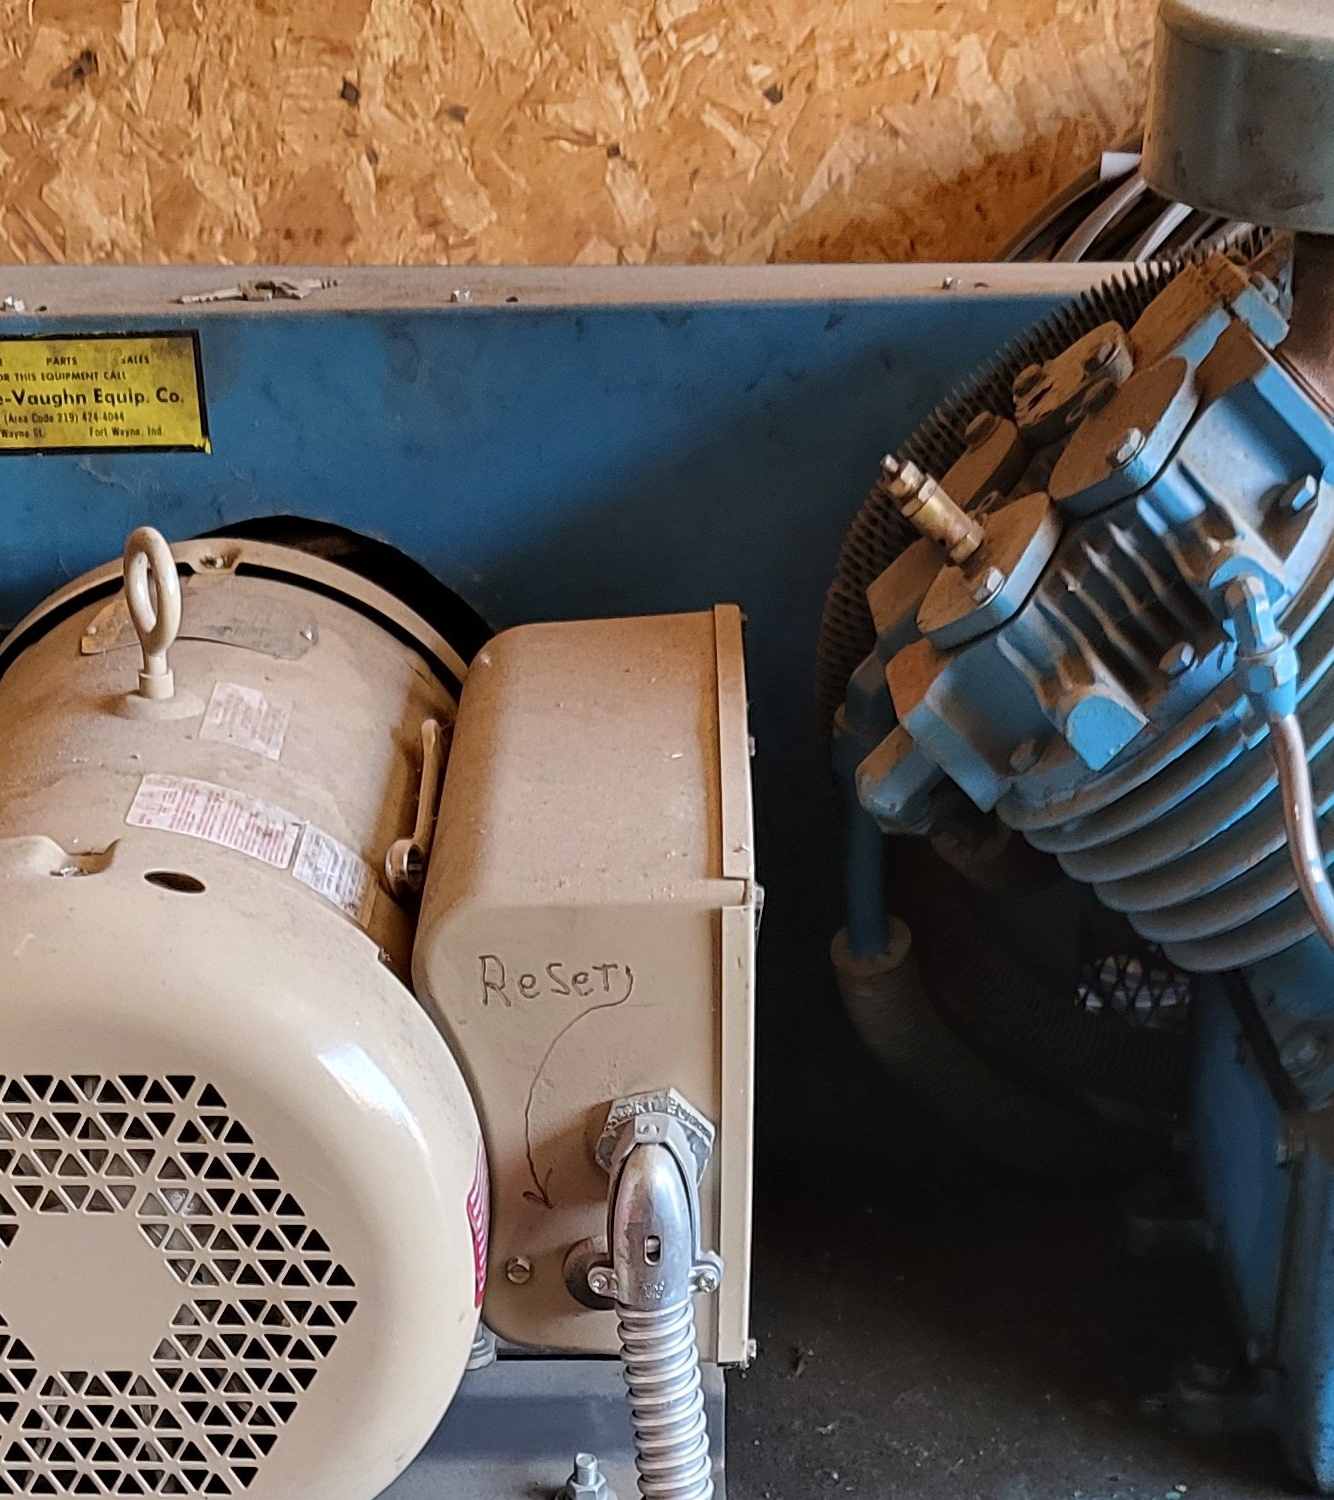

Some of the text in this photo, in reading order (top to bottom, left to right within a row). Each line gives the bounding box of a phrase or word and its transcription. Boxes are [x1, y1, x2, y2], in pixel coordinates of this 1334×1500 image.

[46, 357, 78, 366] PARTS
[121, 355, 150, 365] SALES
[15, 372, 37, 381] THIS
[41, 371, 99, 381] EQUIPMENT
[104, 370, 126, 380] CALL
[93, 387, 150, 407] Equip.
[156, 387, 184, 403] Co.
[4, 413, 29, 425] (Area
[31, 413, 54, 423] Code
[57, 412, 79, 424] 219)
[0, 428, 29, 440] Wayne
[89, 426, 108, 437] Fort
